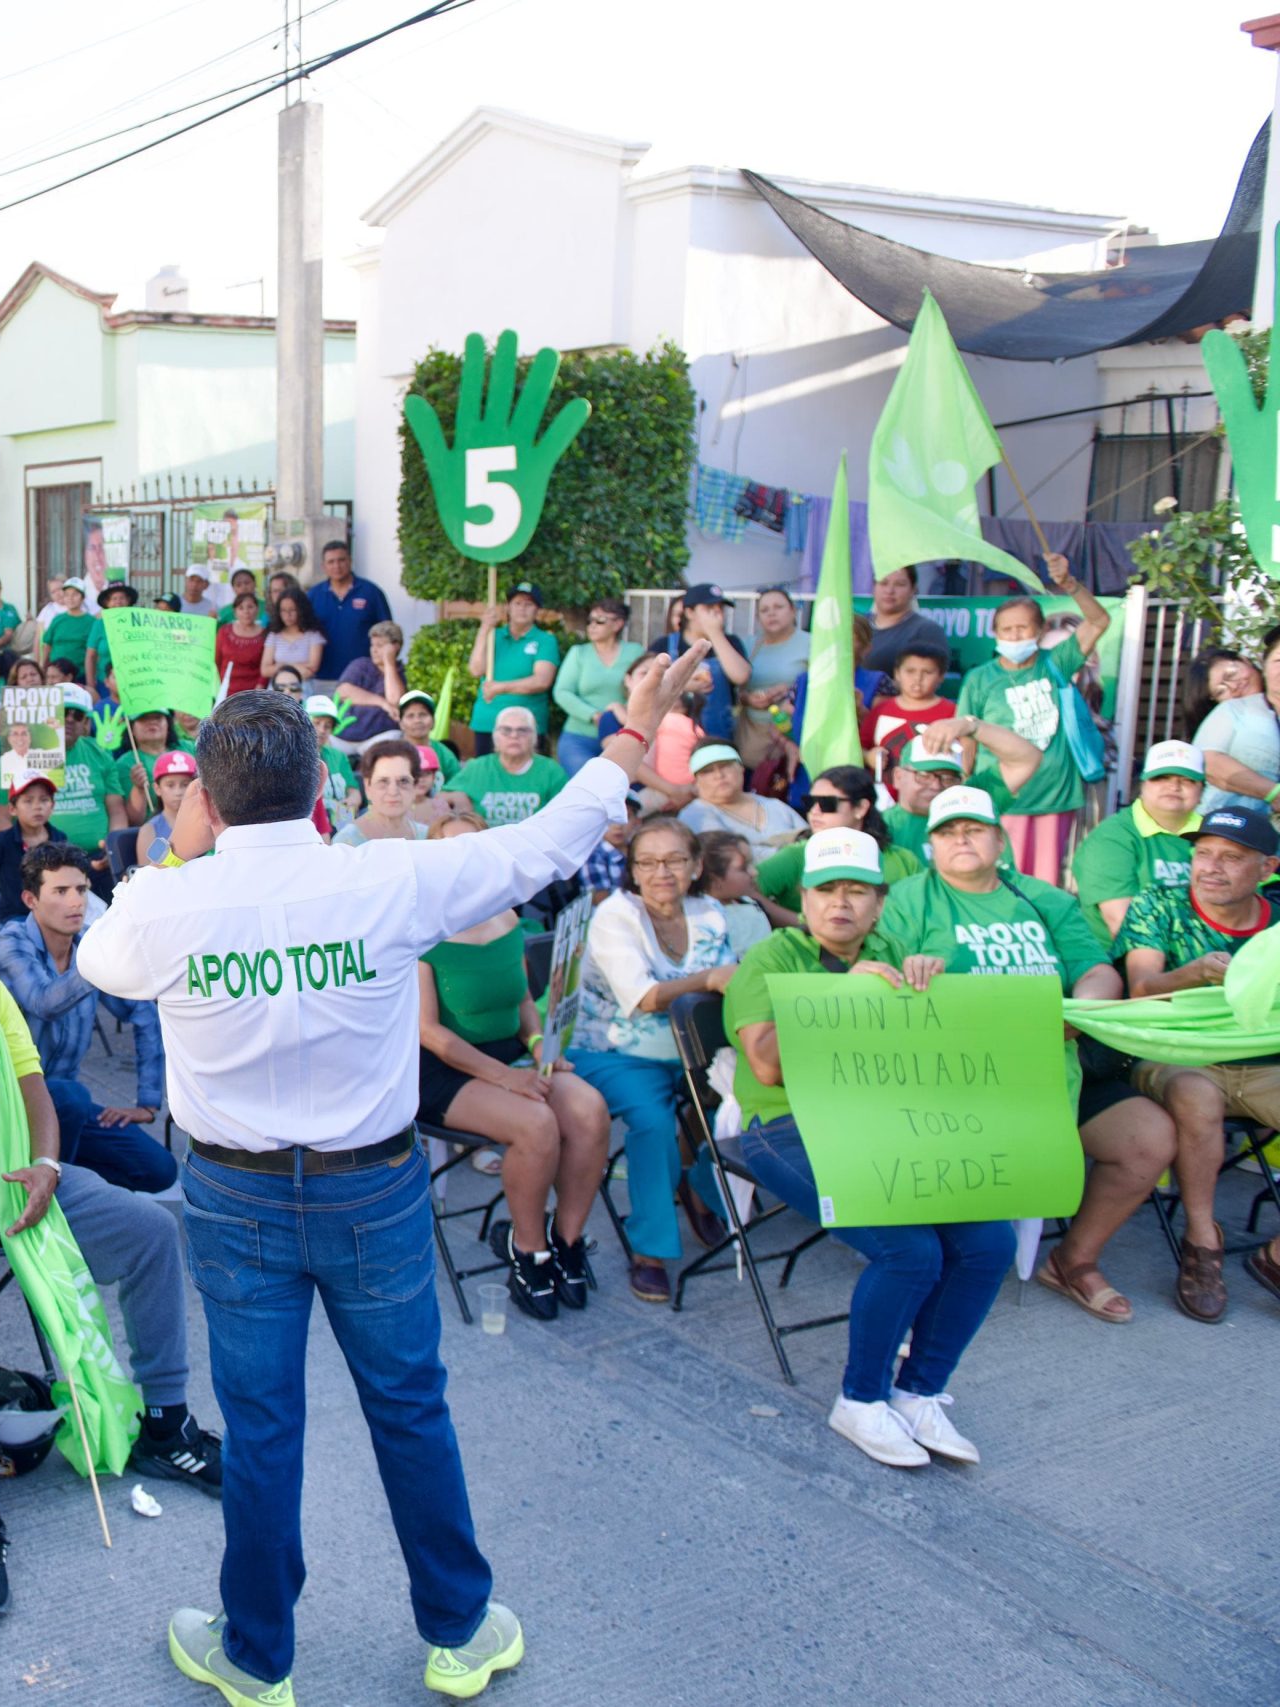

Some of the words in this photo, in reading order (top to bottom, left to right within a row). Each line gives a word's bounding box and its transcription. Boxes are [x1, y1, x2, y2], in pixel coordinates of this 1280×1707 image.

[463, 445, 522, 549] 5
[130, 611, 193, 631] NAVARRO
[3, 687, 62, 706] APOYO
[480, 791, 540, 807] APOYO
[954, 920, 1046, 945] APOYO
[187, 948, 283, 999] APOYO
[285, 938, 377, 992] TOTAL
[968, 941, 1059, 968] TOTAL
[794, 995, 942, 1030] QUINTA
[832, 1051, 1001, 1086] ARBOLADA
[899, 1107, 984, 1137] TODO
[871, 1153, 1012, 1204] VERDE
